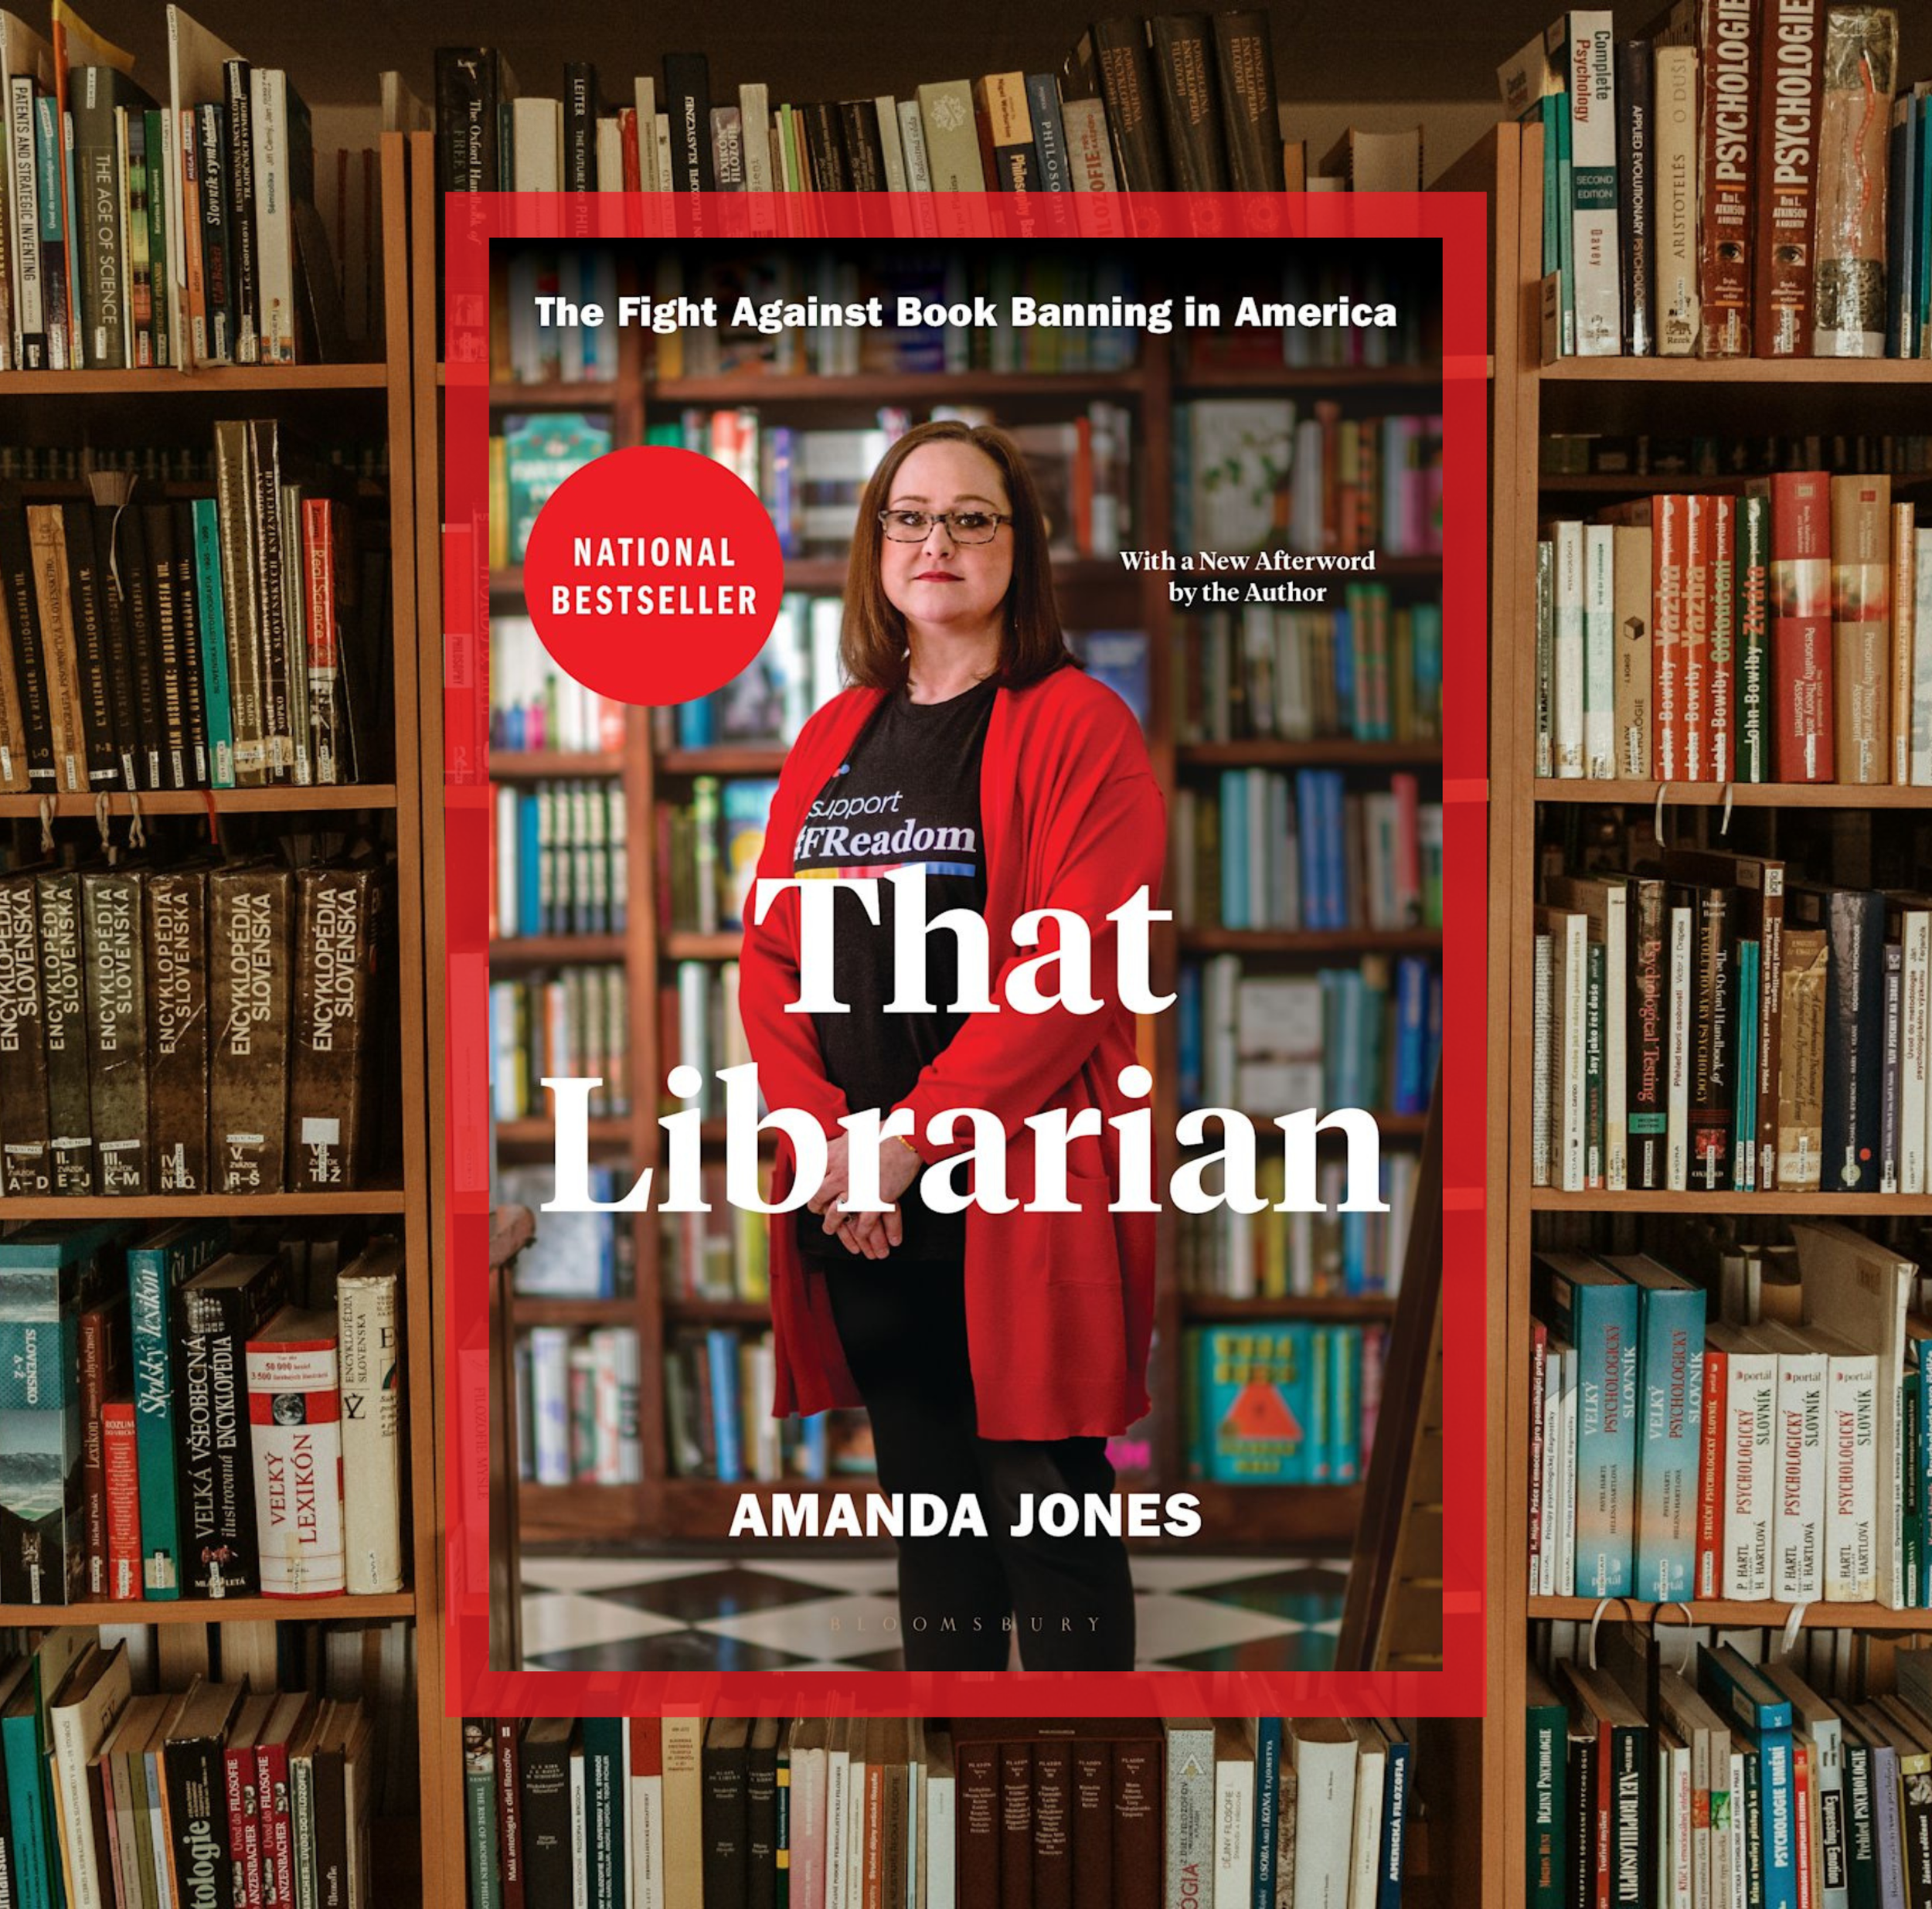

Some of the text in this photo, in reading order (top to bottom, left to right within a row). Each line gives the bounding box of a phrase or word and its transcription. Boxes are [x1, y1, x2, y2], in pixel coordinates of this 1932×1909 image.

[574, 78, 585, 116] LEITER
[1575, 40, 1590, 122] Psychology
[1594, 31, 1610, 100] Complete
[15, 87, 29, 131] PATENTS
[19, 132, 30, 157] AND
[19, 161, 32, 219] STRATEGIC
[1577, 175, 1613, 185] SECOND
[1577, 189, 1613, 199] EDITION
[21, 223, 36, 281] INVENTING
[96, 156, 118, 325] THE AGE OF SCIENCE
[1590, 230, 1602, 266] Davey
[311, 550, 325, 638] Real Science
[1656, 564, 1680, 720] Bowlby Vazba
[1681, 566, 1706, 721] Bowlby Vazba
[1709, 560, 1731, 727] Bowlby Odloučení
[1743, 566, 1765, 703] Bowlby Ztráta
[1804, 627, 1815, 680] Personality
[1794, 679, 1804, 737] Assessment
[1804, 682, 1815, 716] Theory
[808, 791, 903, 819] support
[12, 889, 37, 1016] SLOVENSKA
[42, 887, 65, 1050] ENCYKLOPÉDIA
[58, 888, 79, 1013] SLOVENSKA
[94, 888, 117, 1050] ENCYKLOPÉDIA
[114, 888, 133, 1014] SLOVENSKA
[155, 893, 175, 1053] ENCYKLOPÉDIA
[174, 893, 191, 1018] SLOVENSKA
[226, 893, 250, 1055] ENCYKLOPÉDIA
[252, 893, 270, 1020] SLOVENSKA
[311, 888, 336, 1050] ENCYKLOPÉDIA
[335, 889, 355, 1017] SLOVENSKA
[1771, 917, 1781, 1013] Emotional Intelligence
[1587, 984, 1598, 1075] Sny jako řeč duše
[1638, 938, 1662, 1103] Psychological Testing
[1698, 927, 1711, 1104] EVOLUTIONARY PSYCHOLOGY
[1709, 950, 1726, 1086] The Oxford Handbook of
[26, 1329, 38, 1404] SLOVENSKO
[136, 1268, 173, 1417] Školský lexikón
[342, 1295, 355, 1383] ENCYKLOPÉDIA
[359, 1314, 369, 1383] SLOVENSKA
[1743, 1370, 1771, 1382] portál
[1535, 1377, 1543, 1425] pomáhající
[1583, 1382, 1599, 1435] VELKÝ
[1604, 1323, 1620, 1433] PSYCHOLOGICKÝ
[1621, 1346, 1636, 1419] SLOVNÍK
[1648, 1386, 1665, 1440] VELKÝ
[1669, 1329, 1686, 1439] PSYCHOLOGICKÝ
[1689, 1351, 1704, 1424] SLOVNÍK
[1793, 1372, 1821, 1383] portál
[1844, 1371, 1872, 1383] portál
[184, 1336, 214, 1539] VEĽKÁ VŠEOBECNÁ
[208, 1336, 236, 1537] ilustrovaná ENCYKLOPÉDIA
[1753, 1388, 1771, 1446] SLOVNÍK
[1801, 1390, 1820, 1447] SLOVNÍK
[1854, 1390, 1871, 1446] SLOVNÍK
[265, 1451, 285, 1526] VEĽKÝ
[291, 1434, 317, 1545] LEXIKÓN
[1532, 1442, 1541, 1482] emocemi
[1704, 1400, 1717, 1540] STRUČNÝ PSYCHOLOGICKÝ SLOVNÍK
[1734, 1410, 1754, 1515] PSYCHOLOGICKÝ
[1783, 1410, 1803, 1516] PSYCHOLOGICKÝ
[1836, 1410, 1854, 1516] PSYCHOLOGICKÝ
[1531, 1489, 1539, 1514] Práce
[1737, 1546, 1749, 1577] HARTL
[1754, 1520, 1767, 1590] H. HARTLOVÁ
[1784, 1546, 1798, 1591] P. HARTL
[1802, 1522, 1815, 1591] H. HARTLOVÁ
[1840, 1545, 1851, 1577] HARTL
[1856, 1521, 1869, 1576] HARTLOVÁ
[228, 1759, 241, 1811] FILOSOFIE
[258, 1756, 271, 1809] FILOSOFIE
[1536, 1727, 1553, 1789] PSYCHOLOGIE
[505, 1788, 514, 1807] diel
[1389, 1758, 1404, 1882] AMERICKÁ FILOZOFIA
[1768, 1746, 1788, 1867] PSYCHOLOGIE UMĚNÍ
[1852, 1750, 1871, 1860] Přehled PSYCHOLOGIE
[245, 1825, 261, 1905] ANZENBACHER
[276, 1822, 291, 1901] ANZENBACHER
[478, 1806, 489, 1880] RISE OF MODERN
[507, 1863, 518, 1882] Malá
[1599, 1810, 1610, 1873] Tvořivé myšlení
[1827, 1846, 1842, 1884] Emotion
